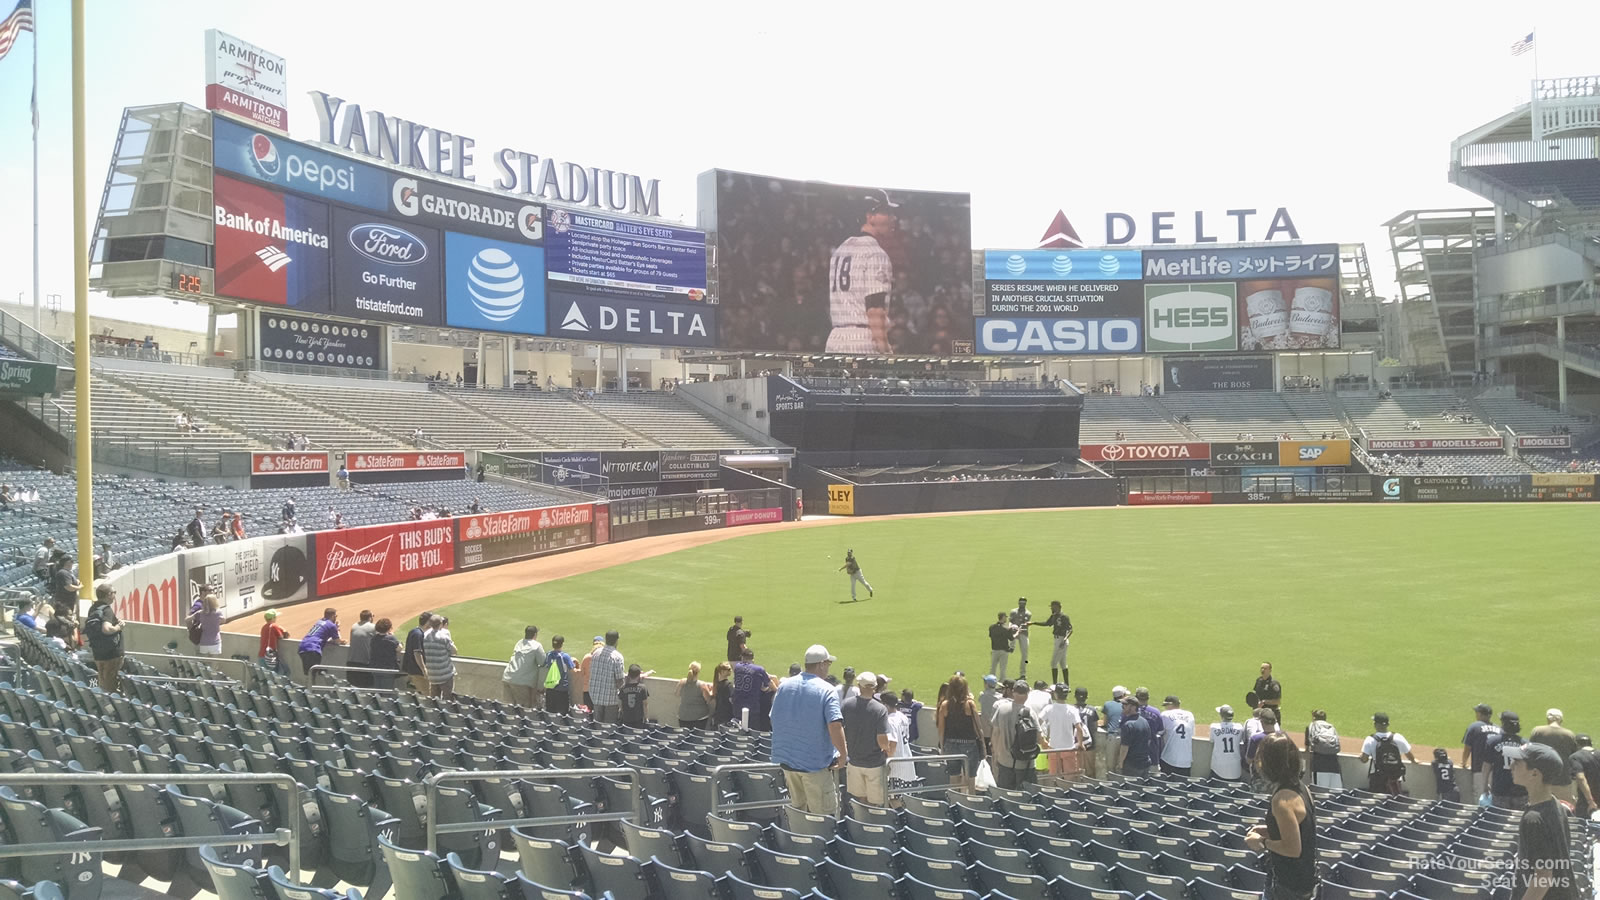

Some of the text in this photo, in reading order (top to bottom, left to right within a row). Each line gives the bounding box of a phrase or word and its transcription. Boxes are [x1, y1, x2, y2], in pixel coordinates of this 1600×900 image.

[219, 40, 284, 76] ARMITRON
[223, 91, 281, 121] ARMITRON
[252, 112, 280, 128] WATCHES
[307, 90, 661, 217] YANKEE STADIUM
[286, 154, 355, 192] pepsi
[392, 178, 542, 240] G GATORADE G
[216, 205, 328, 249] Bank of America
[575, 216, 672, 238] MASTERCARD BATTER'S EYE SEATS
[1106, 206, 1301, 245] DELTA
[364, 228, 412, 260] Ford
[571, 232, 590, 240] Located
[572, 239, 598, 248] Semiprivate
[572, 246, 599, 254] All-inclusive
[621, 253, 649, 261] nonalcoholic
[592, 256, 617, 264] MasterCard
[1146, 254, 1232, 277] MetLife
[1238, 253, 1335, 273] メットライフ
[362, 271, 416, 291] Go Further
[832, 255, 852, 293] 18
[179, 274, 200, 293] 2:25
[356, 296, 423, 318] tristateford.com
[600, 306, 707, 337] DELTA
[1154, 307, 1228, 328] HESS
[294, 334, 307, 344] New
[308, 336, 322, 348] York
[982, 320, 1138, 352] CASIO
[1, 361, 32, 383] Spring
[1372, 440, 1415, 448] MODELL'S
[1432, 439, 1498, 448] MODELLS.com
[1522, 438, 1566, 446] MODELL'S
[1126, 445, 1190, 458] TOYOTA
[1216, 452, 1272, 461] COACH
[1299, 448, 1322, 458] SAP
[485, 464, 499, 472] Clean
[602, 460, 659, 473] NITTOTIRE.COM
[1190, 468, 1216, 476] FedEx
[1383, 478, 1400, 496] G
[1496, 476, 1521, 486] pepsi
[399, 527, 452, 550] THIS BUD'S
[243, 549, 258, 559] OFFICIAL
[464, 544, 482, 554] ROCKIES
[235, 558, 258, 575] ON-FIELD
[327, 550, 386, 570] Budweiser
[400, 548, 443, 572] FOR YOU.
[464, 554, 483, 564] YANKEES
[209, 572, 223, 586] NEW
[245, 574, 249, 583] OF
[735, 674, 753, 691] 28
[627, 694, 636, 708] 5
[1176, 724, 1186, 739] 4
[1214, 728, 1240, 736] GARDNER
[1222, 737, 1234, 753] 11
[1441, 769, 1449, 780] 2
